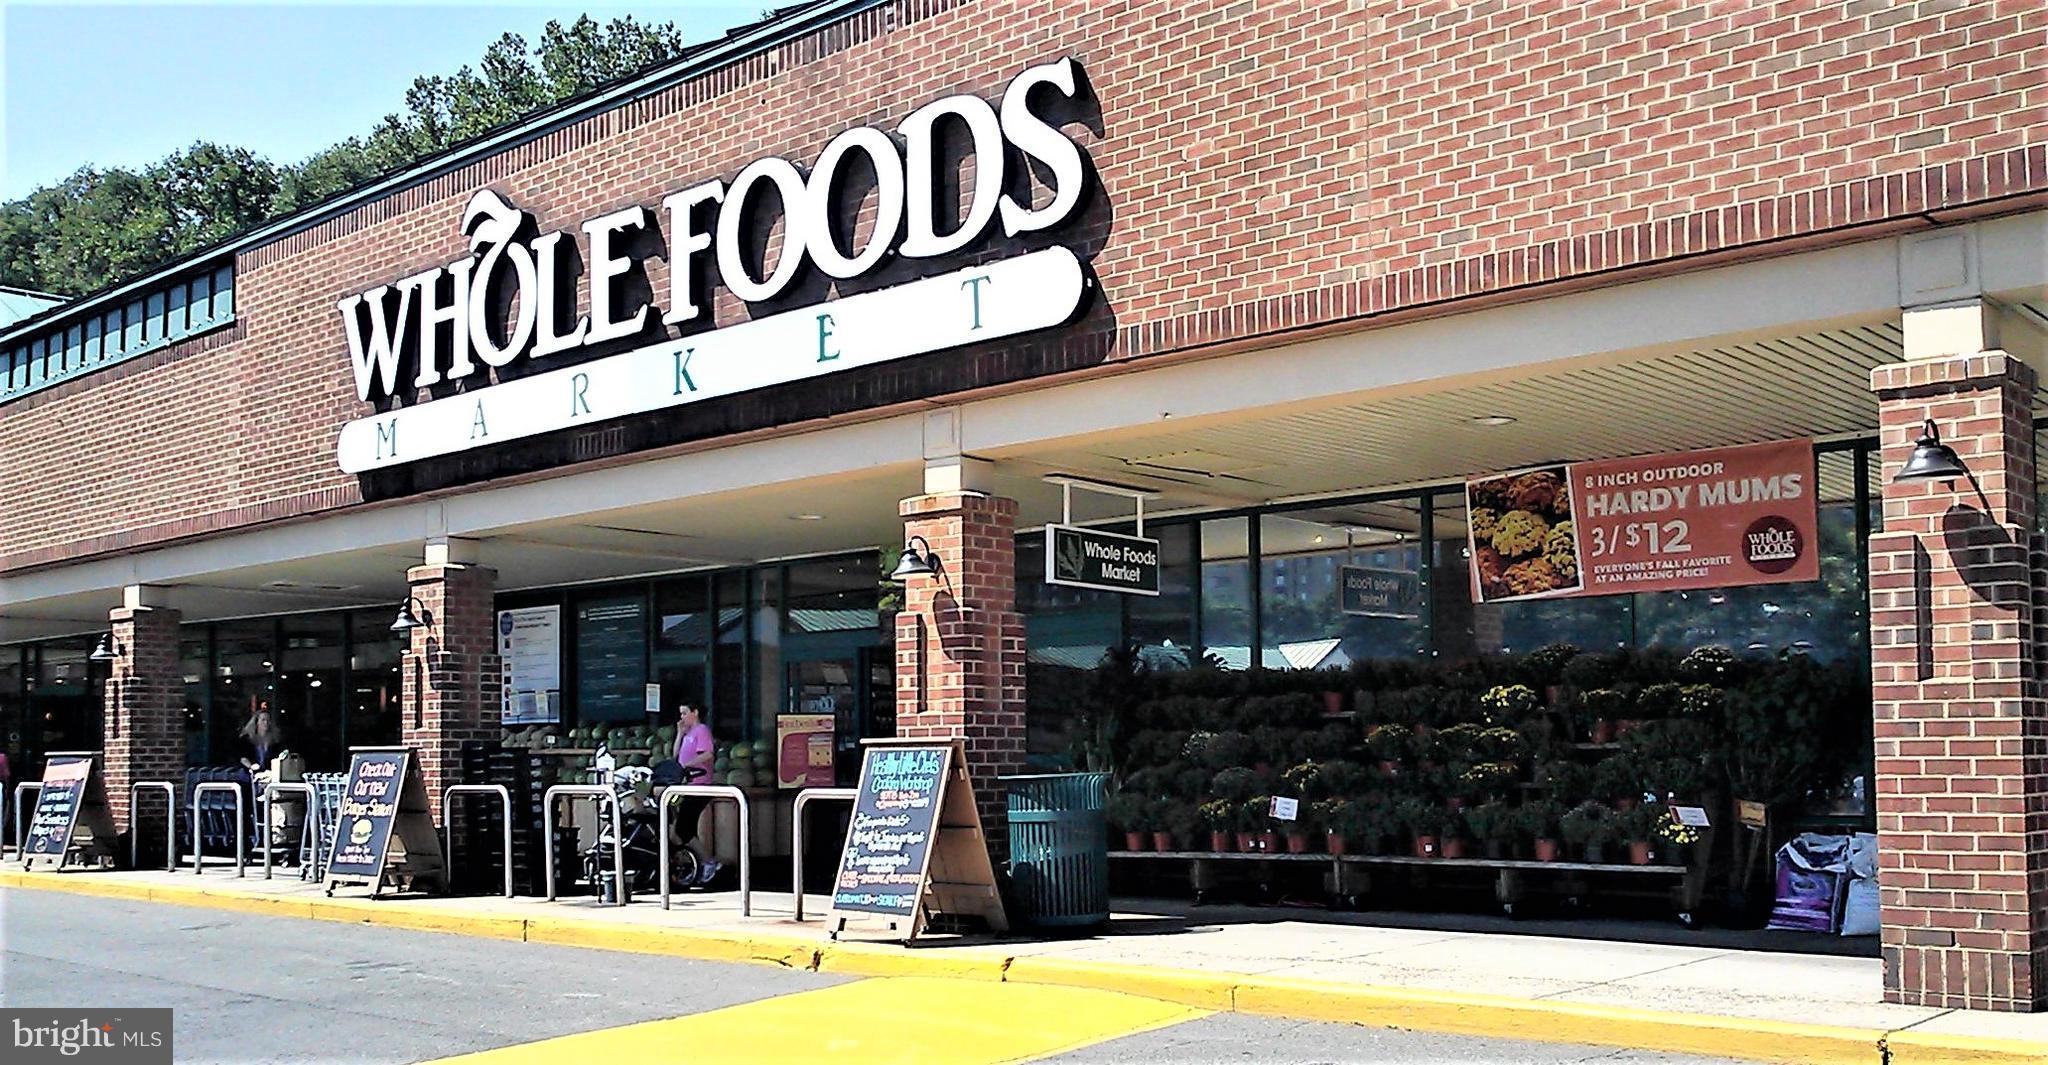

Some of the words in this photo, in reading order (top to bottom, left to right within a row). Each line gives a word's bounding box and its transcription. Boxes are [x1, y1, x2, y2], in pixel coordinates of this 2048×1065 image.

[337, 190, 650, 402] WHOLE
[664, 56, 1085, 324] FOODS
[376, 273, 991, 461] MARKET
[1585, 476, 1594, 489] 8
[1598, 471, 1638, 487] INCH
[1643, 462, 1724, 482] OUTDOOR
[1586, 485, 1692, 518] HARDY
[1699, 473, 1802, 507] MUMS
[1748, 527, 1796, 545] WHOLE
[1084, 541, 1121, 561] Whole
[1123, 546, 1157, 566] Foods
[1751, 542, 1794, 556] FOODS
[1101, 562, 1140, 582] Market
[1594, 560, 1654, 574] EVERYONE'S
[1656, 558, 1680, 569] FALL
[1683, 555, 1732, 567] FAVORITE
[1595, 574, 1607, 584] AT
[1609, 572, 1624, 582] AN
[1626, 568, 1674, 580] AMAZING
